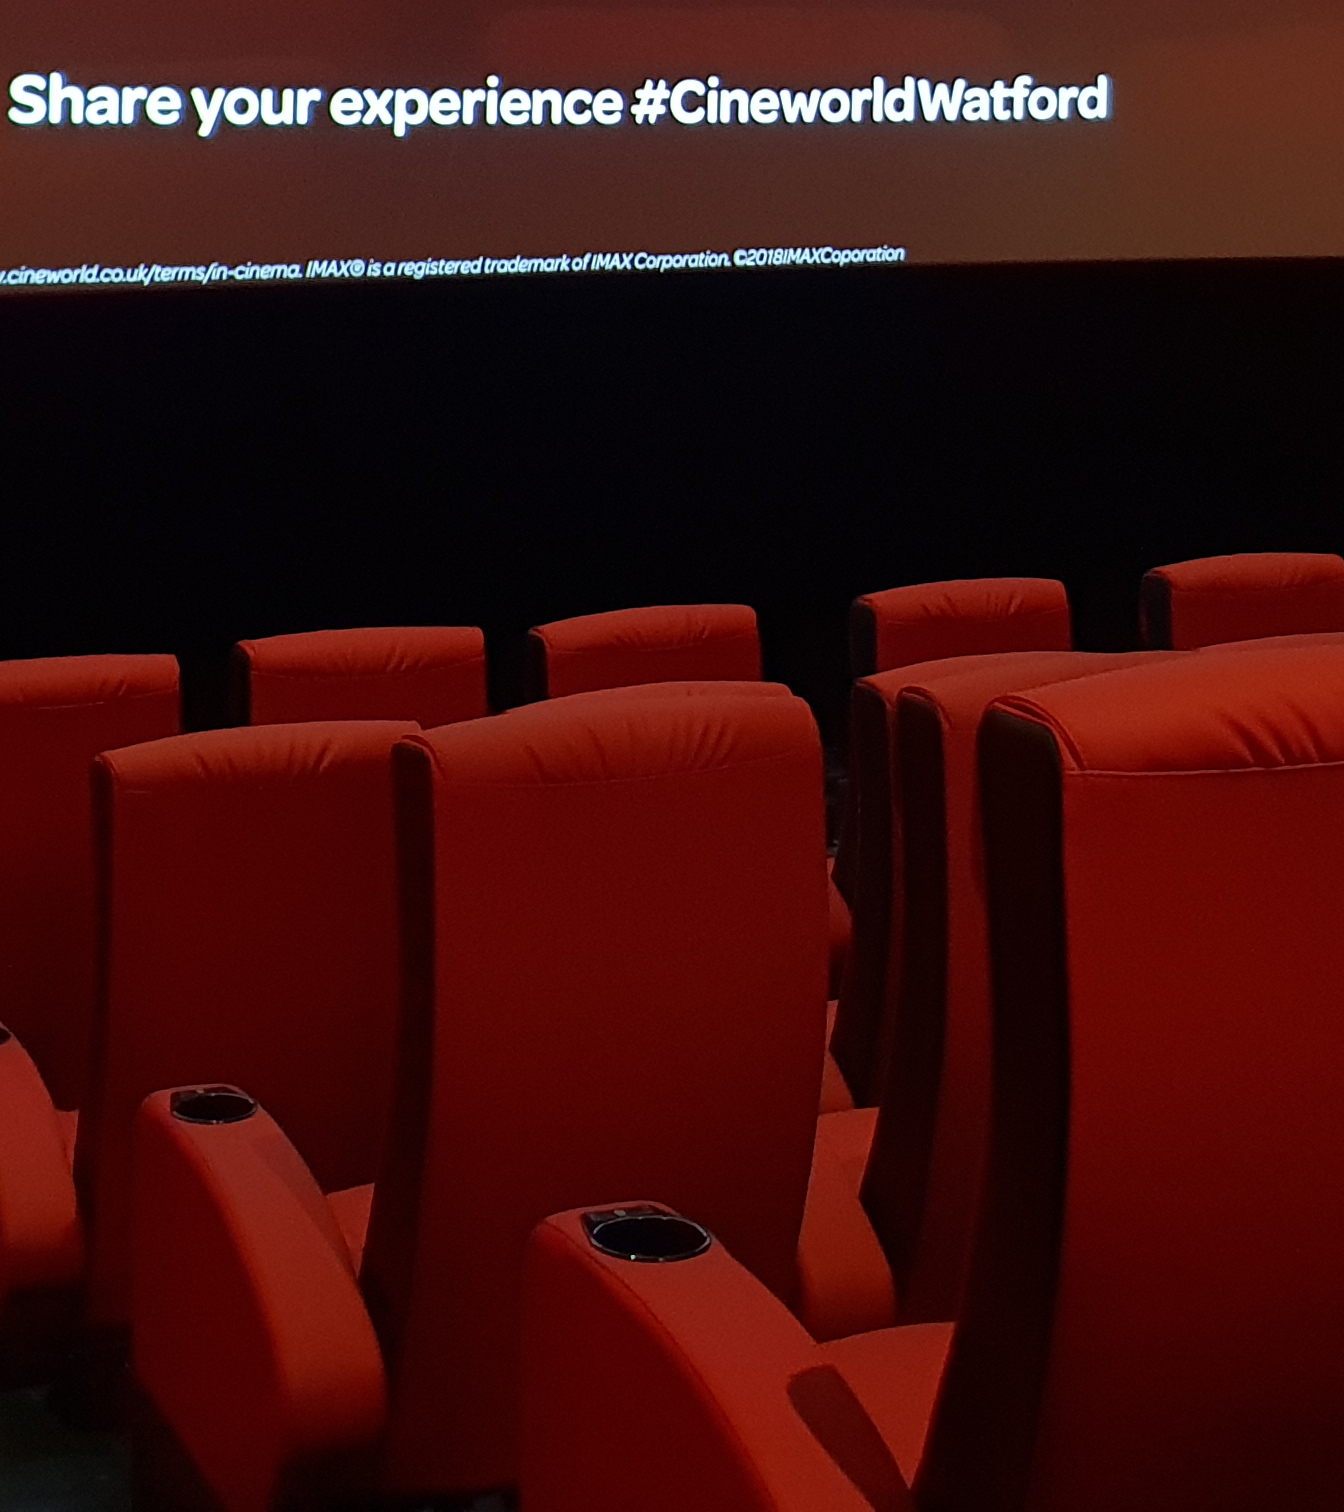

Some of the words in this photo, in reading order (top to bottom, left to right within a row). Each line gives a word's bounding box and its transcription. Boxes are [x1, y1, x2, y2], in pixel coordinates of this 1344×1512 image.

[8, 71, 184, 127] Share
[190, 86, 323, 139] your
[329, 74, 625, 139] experience
[630, 74, 1110, 126] #CineworldWatford
[367, 258, 382, 277] is
[382, 261, 396, 276] a
[397, 256, 483, 280] registered
[484, 253, 571, 275] trademark
[571, 252, 591, 271] of
[591, 252, 635, 271] IMAX
[634, 250, 732, 273] Corporation.
